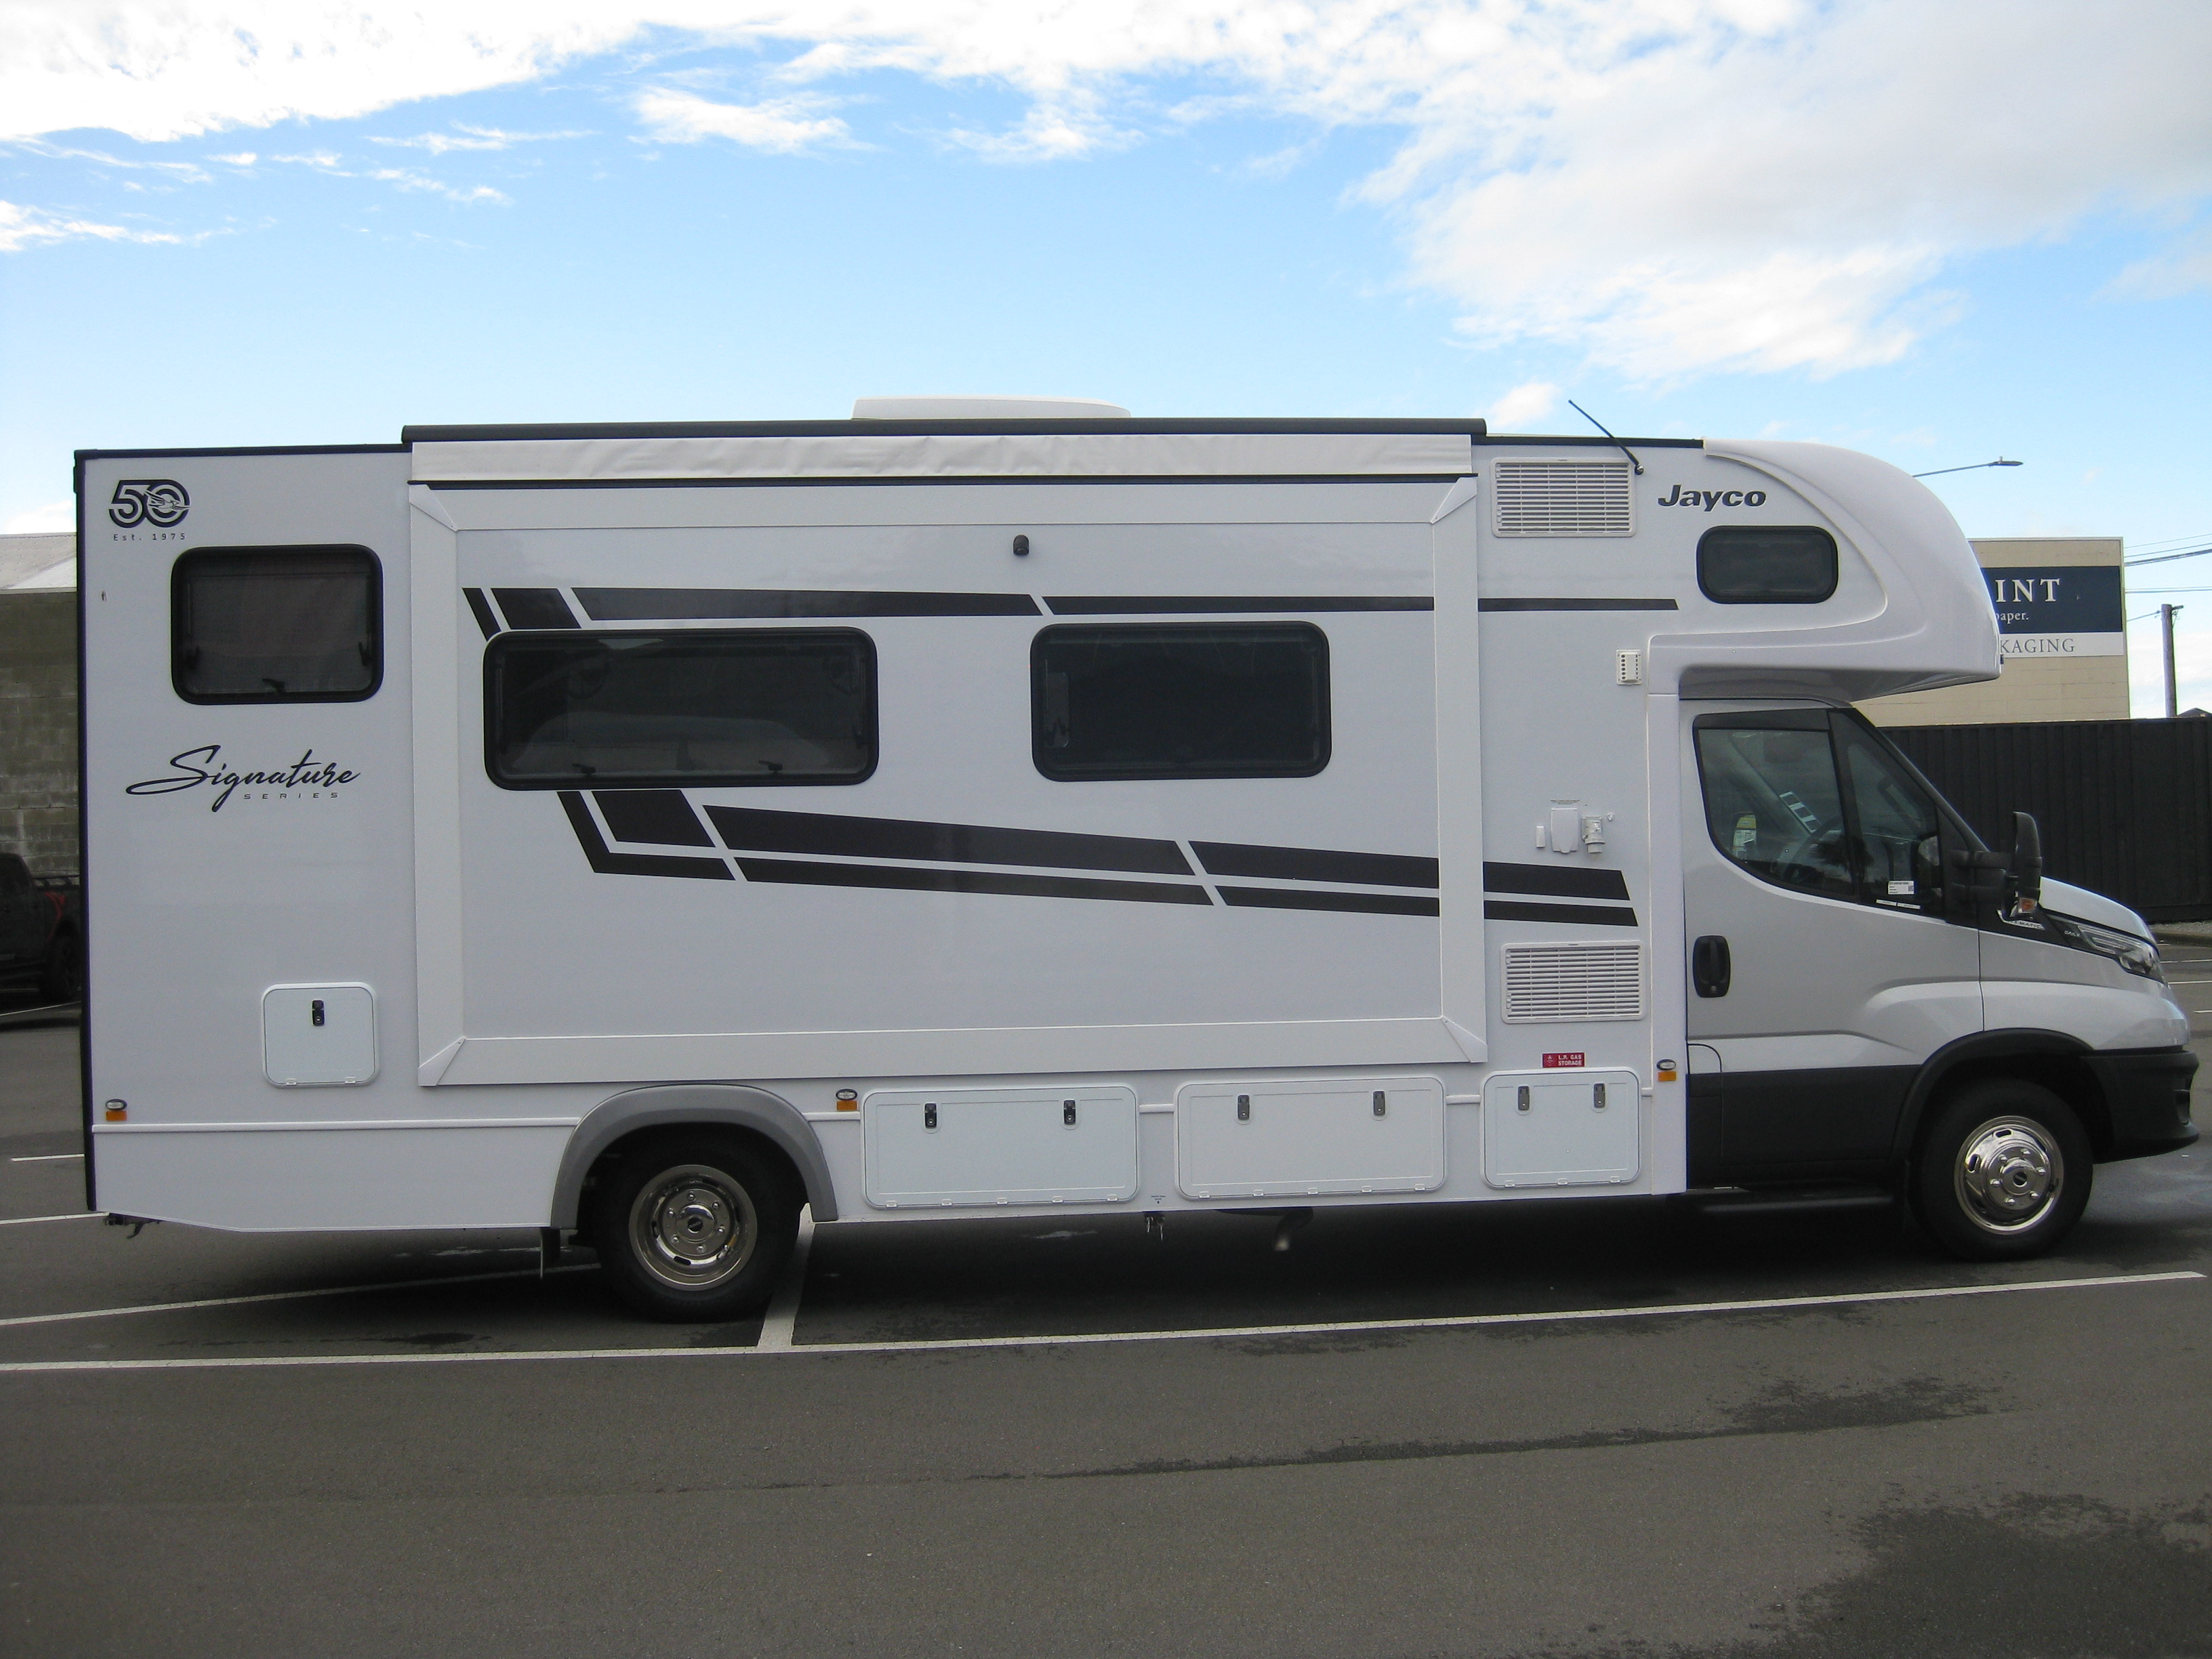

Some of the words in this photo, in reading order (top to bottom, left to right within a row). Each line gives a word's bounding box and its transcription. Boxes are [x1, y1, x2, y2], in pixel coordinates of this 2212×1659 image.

[108, 478, 190, 529] 50
[1657, 484, 1767, 512] Jayco
[113, 533, 143, 541] Est.
[152, 533, 186, 541] 1975
[1994, 578, 2060, 602] INT
[125, 744, 362, 813] Signature
[243, 792, 339, 800] SERIES
